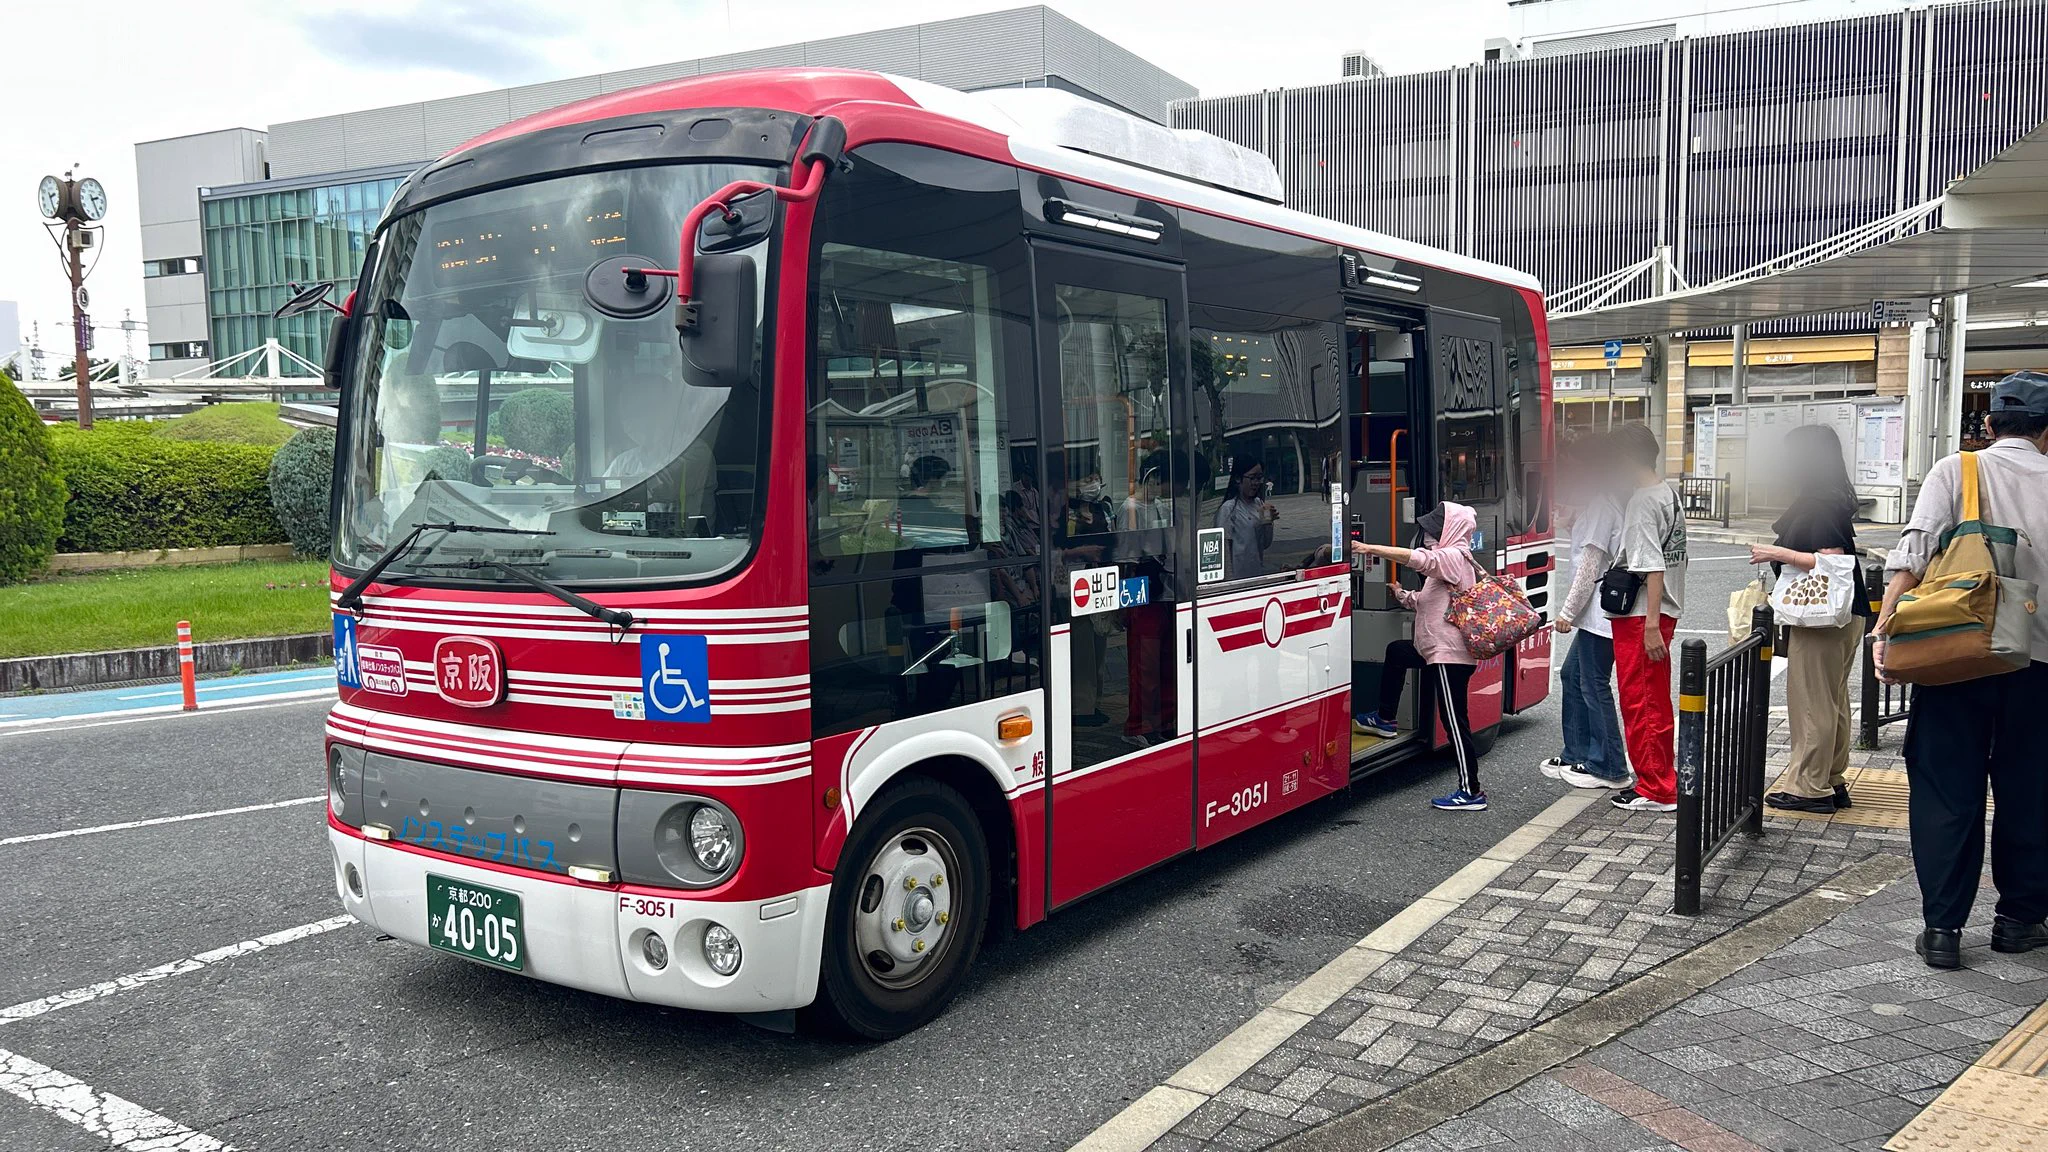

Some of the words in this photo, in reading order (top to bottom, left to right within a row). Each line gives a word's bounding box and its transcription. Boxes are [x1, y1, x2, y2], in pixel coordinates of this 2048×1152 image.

[1875, 302, 1884, 318] 2
[1203, 540, 1219, 553] NBA
[1092, 572, 1117, 594] 出口
[1095, 595, 1114, 609] EXIT
[441, 651, 493, 692] 京阪
[1014, 750, 1044, 778] 一般
[1205, 781, 1268, 828] F-3051
[399, 816, 563, 871] ノンステップバス
[620, 897, 674, 918] F-3051
[432, 913, 442, 928] か
[444, 904, 517, 962] 40-05
